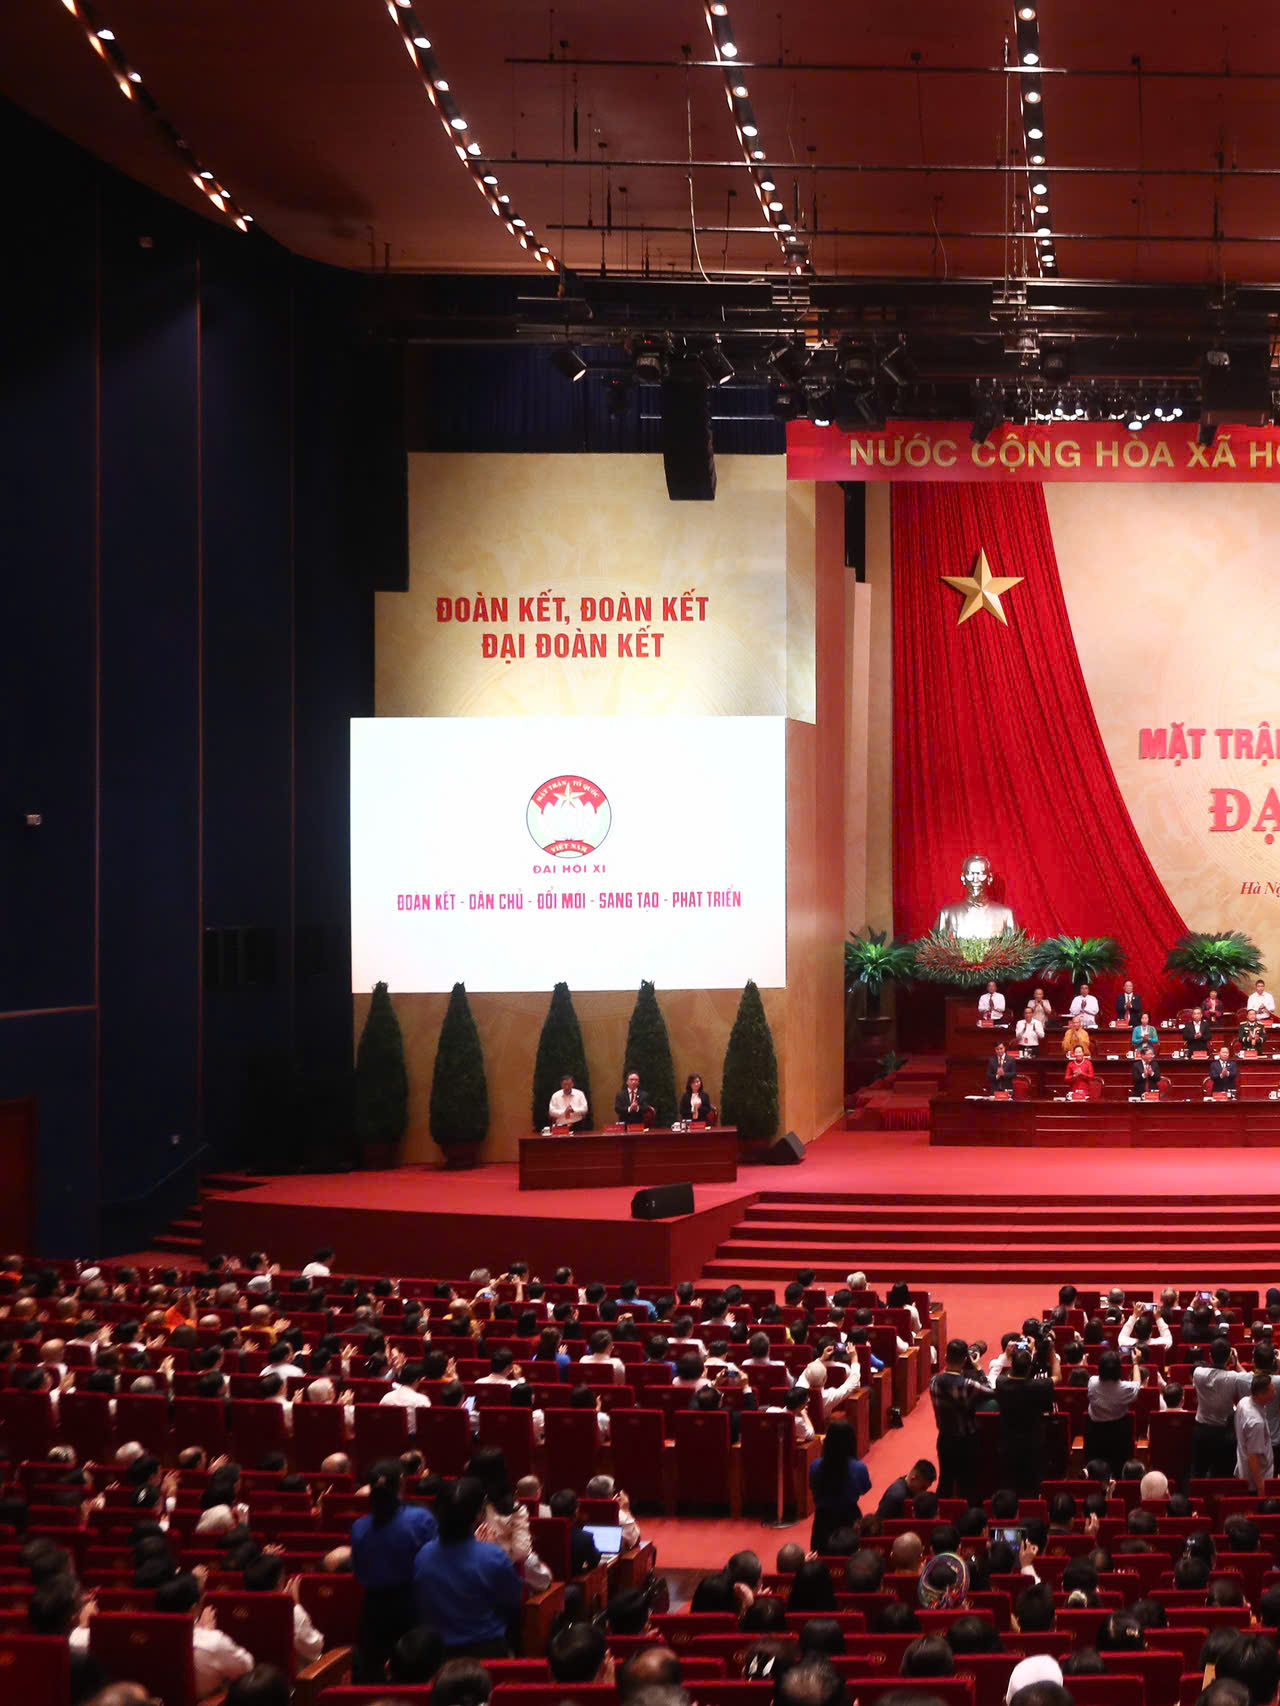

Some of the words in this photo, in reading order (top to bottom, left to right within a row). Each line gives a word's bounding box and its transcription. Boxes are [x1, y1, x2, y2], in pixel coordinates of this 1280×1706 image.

[850, 432, 958, 467] NƯỚC
[971, 433, 1081, 473] CỘNG
[1096, 434, 1174, 468] HÒA
[1187, 434, 1237, 468] XÃ
[436, 592, 508, 623] ĐOÀN
[519, 588, 571, 625] KẾT,
[580, 591, 652, 622] ĐOÀN
[662, 588, 709, 622] KẾT
[481, 633, 525, 664] ĐẠI
[535, 628, 607, 658] ĐOÀN
[617, 625, 664, 658] KẾT
[1138, 721, 1206, 767] MẶT
[593, 864, 606, 874] XI
[1240, 881, 1261, 895] Hà
